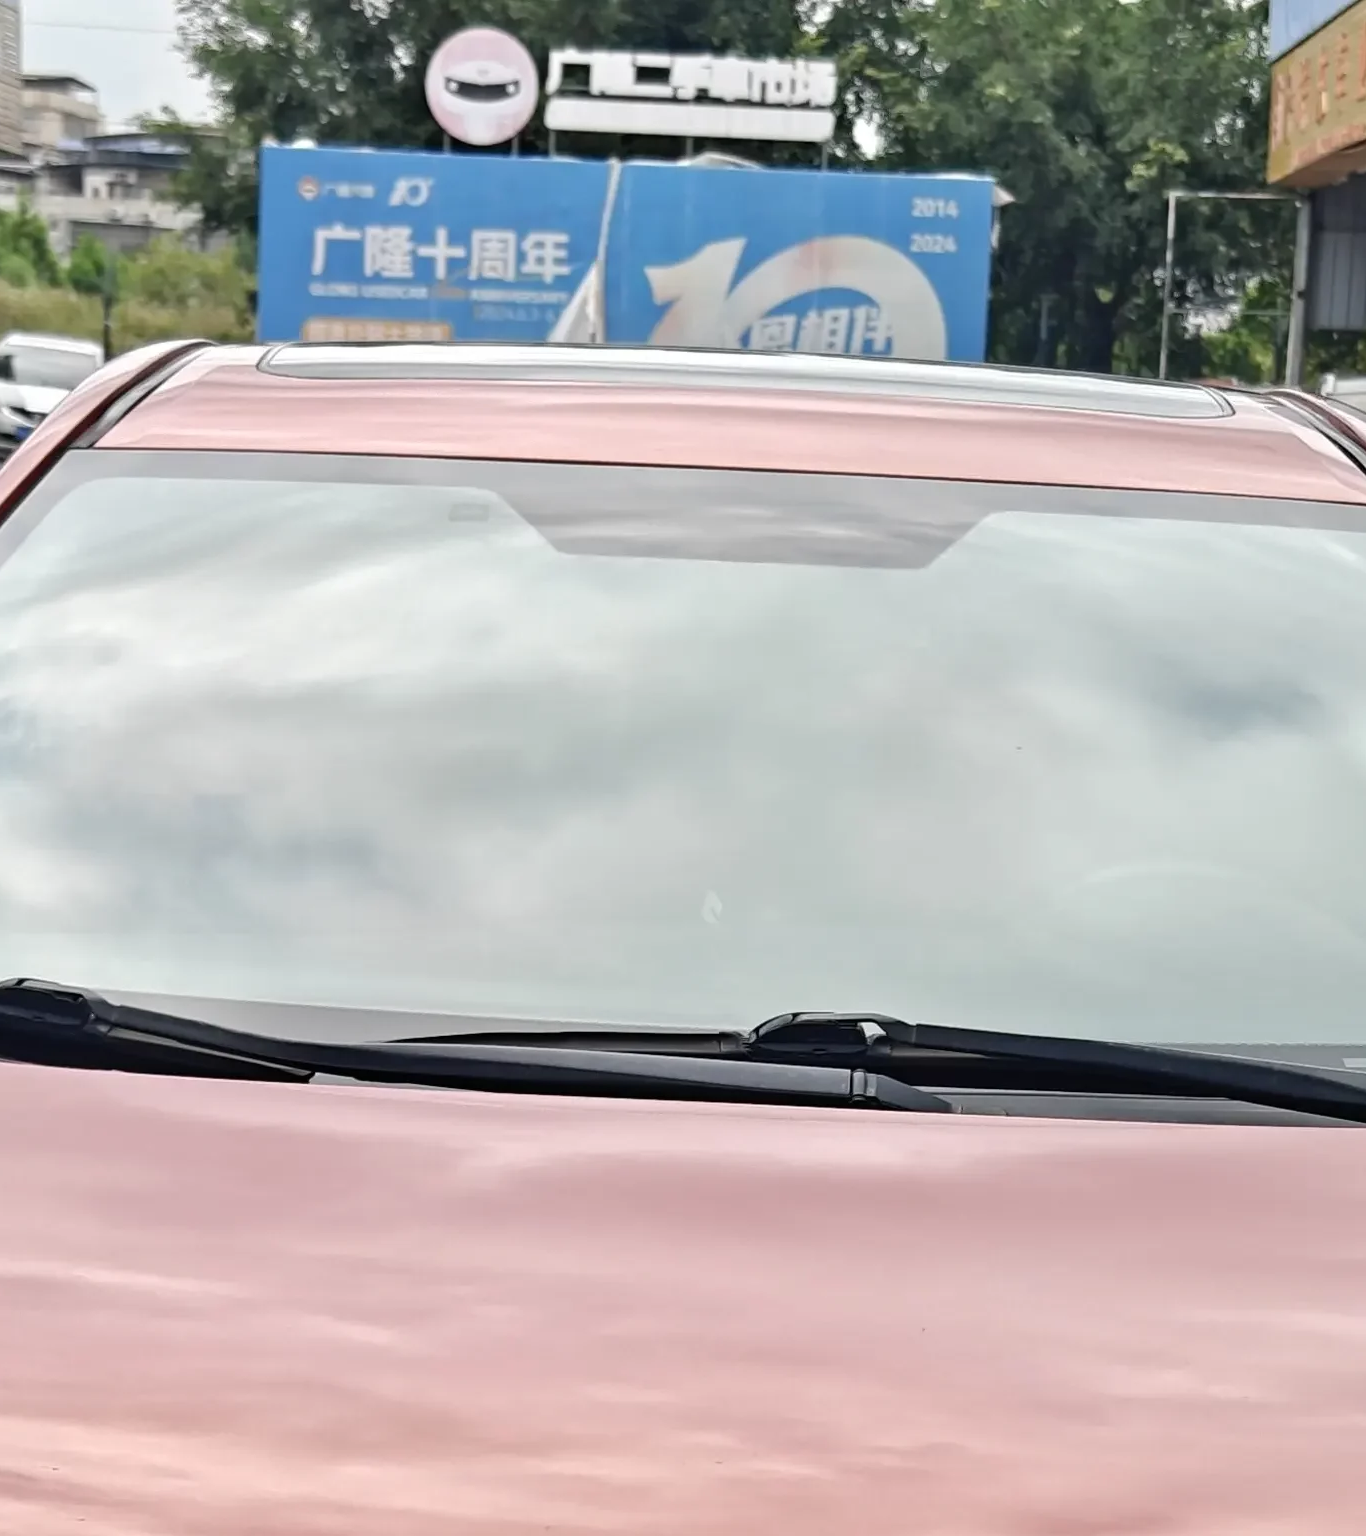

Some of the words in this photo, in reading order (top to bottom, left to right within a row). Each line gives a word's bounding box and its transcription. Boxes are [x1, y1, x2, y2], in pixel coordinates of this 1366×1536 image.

[911, 197, 959, 219] 2014
[311, 223, 572, 284] 广隆十周年
[910, 234, 957, 254] 2024
